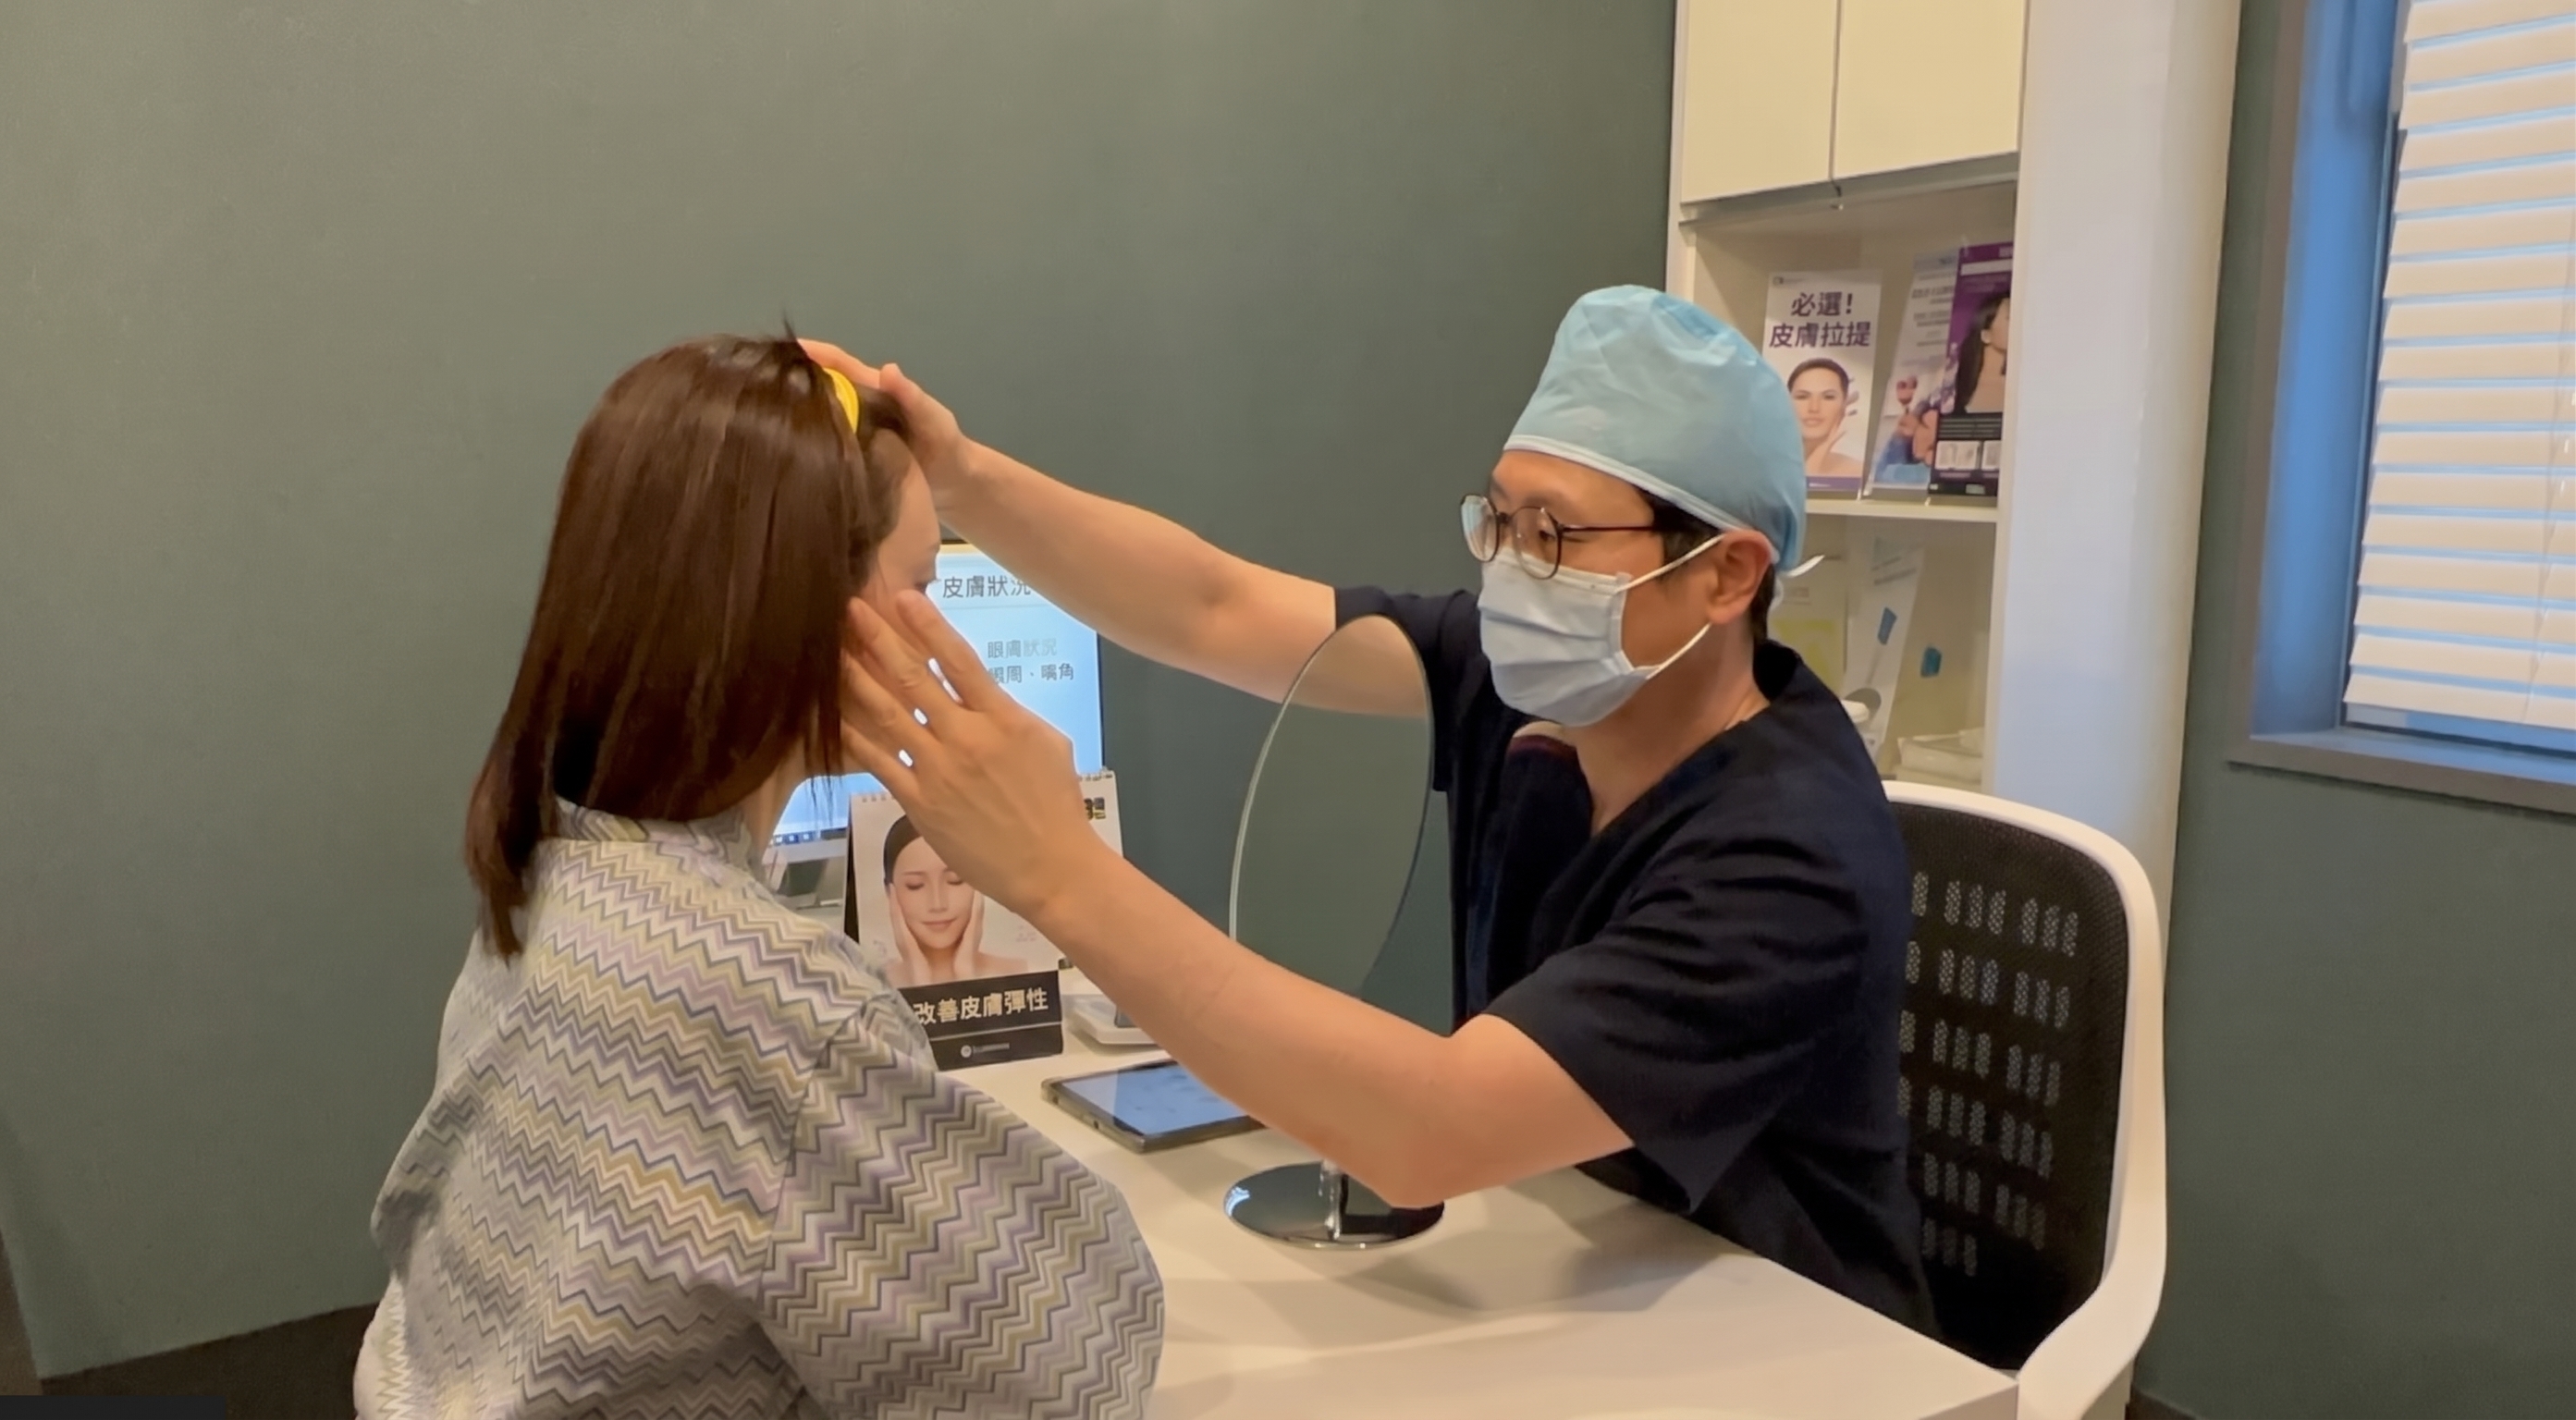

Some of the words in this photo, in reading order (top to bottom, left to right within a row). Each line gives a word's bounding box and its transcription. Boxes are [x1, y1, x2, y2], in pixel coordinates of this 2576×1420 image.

[1769, 321, 1871, 348] 皮膚拉提
[913, 987, 1049, 1025] 改善皮膚彈性
